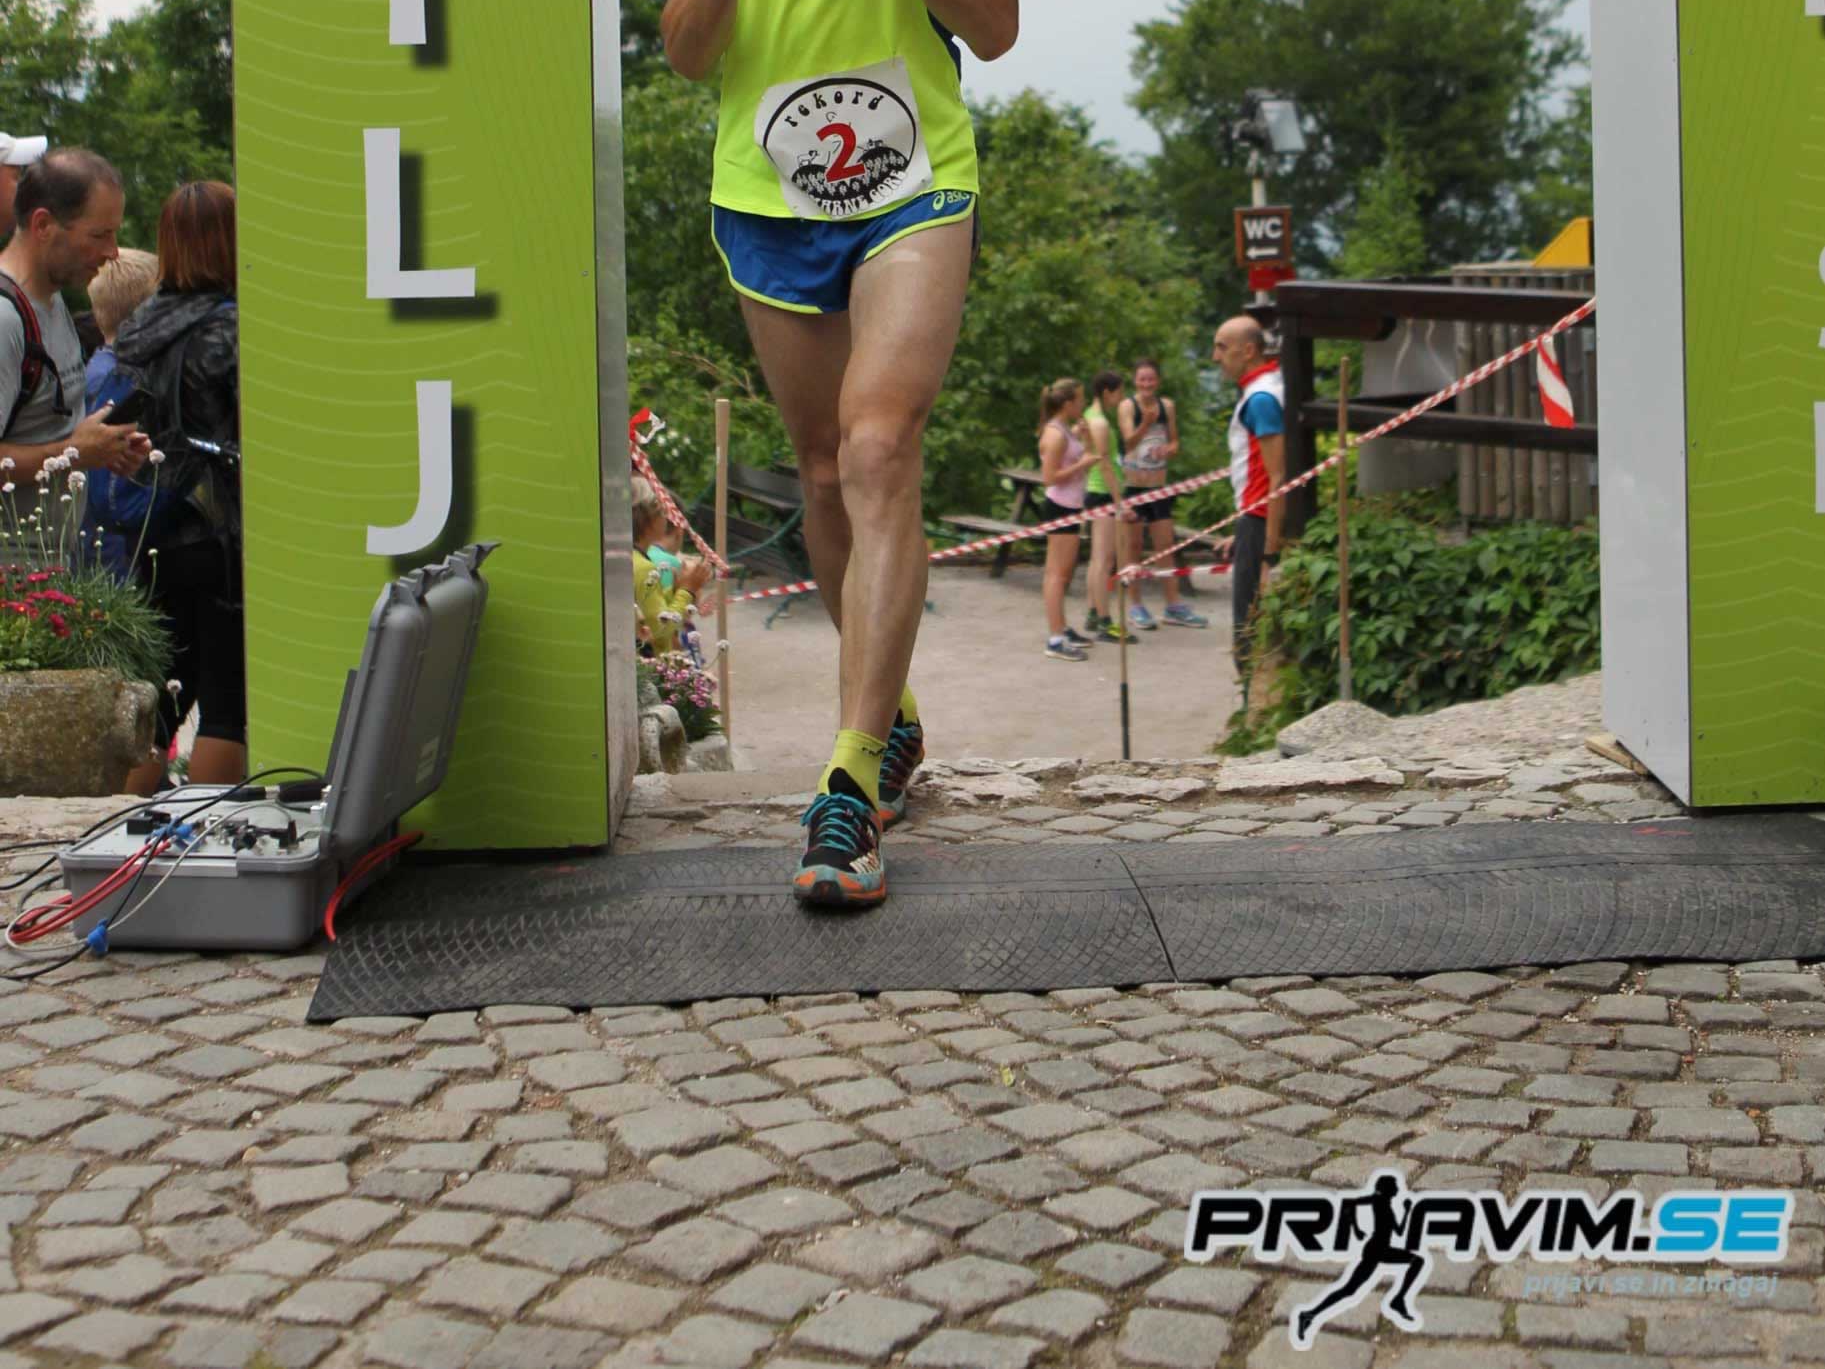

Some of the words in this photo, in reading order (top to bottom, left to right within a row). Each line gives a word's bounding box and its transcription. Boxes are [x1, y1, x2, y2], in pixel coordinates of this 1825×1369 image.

[784, 90, 884, 128] rekord
[815, 122, 866, 183] 2
[1243, 217, 1283, 240] WC
